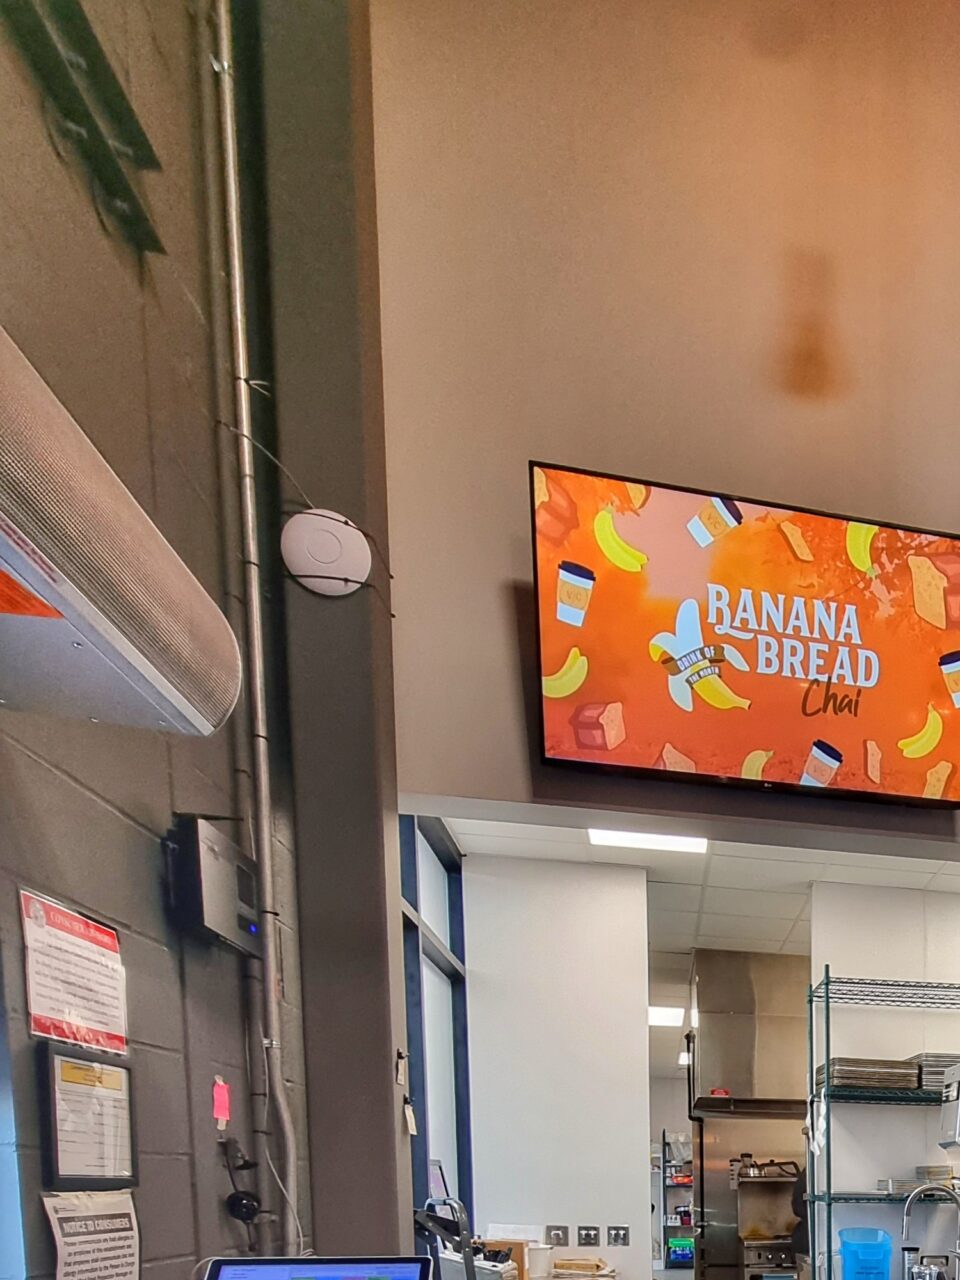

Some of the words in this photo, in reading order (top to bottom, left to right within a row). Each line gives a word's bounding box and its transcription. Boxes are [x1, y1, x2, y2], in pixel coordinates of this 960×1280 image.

[707, 583, 862, 644] BANANA
[678, 651, 702, 671] DRINK
[704, 646, 716, 658] OF
[756, 634, 880, 688] BREAD
[801, 676, 862, 717] Chai
[63, 1221, 87, 1233] NOTICE
[95, 1218, 130, 1230] CONSUMERS
